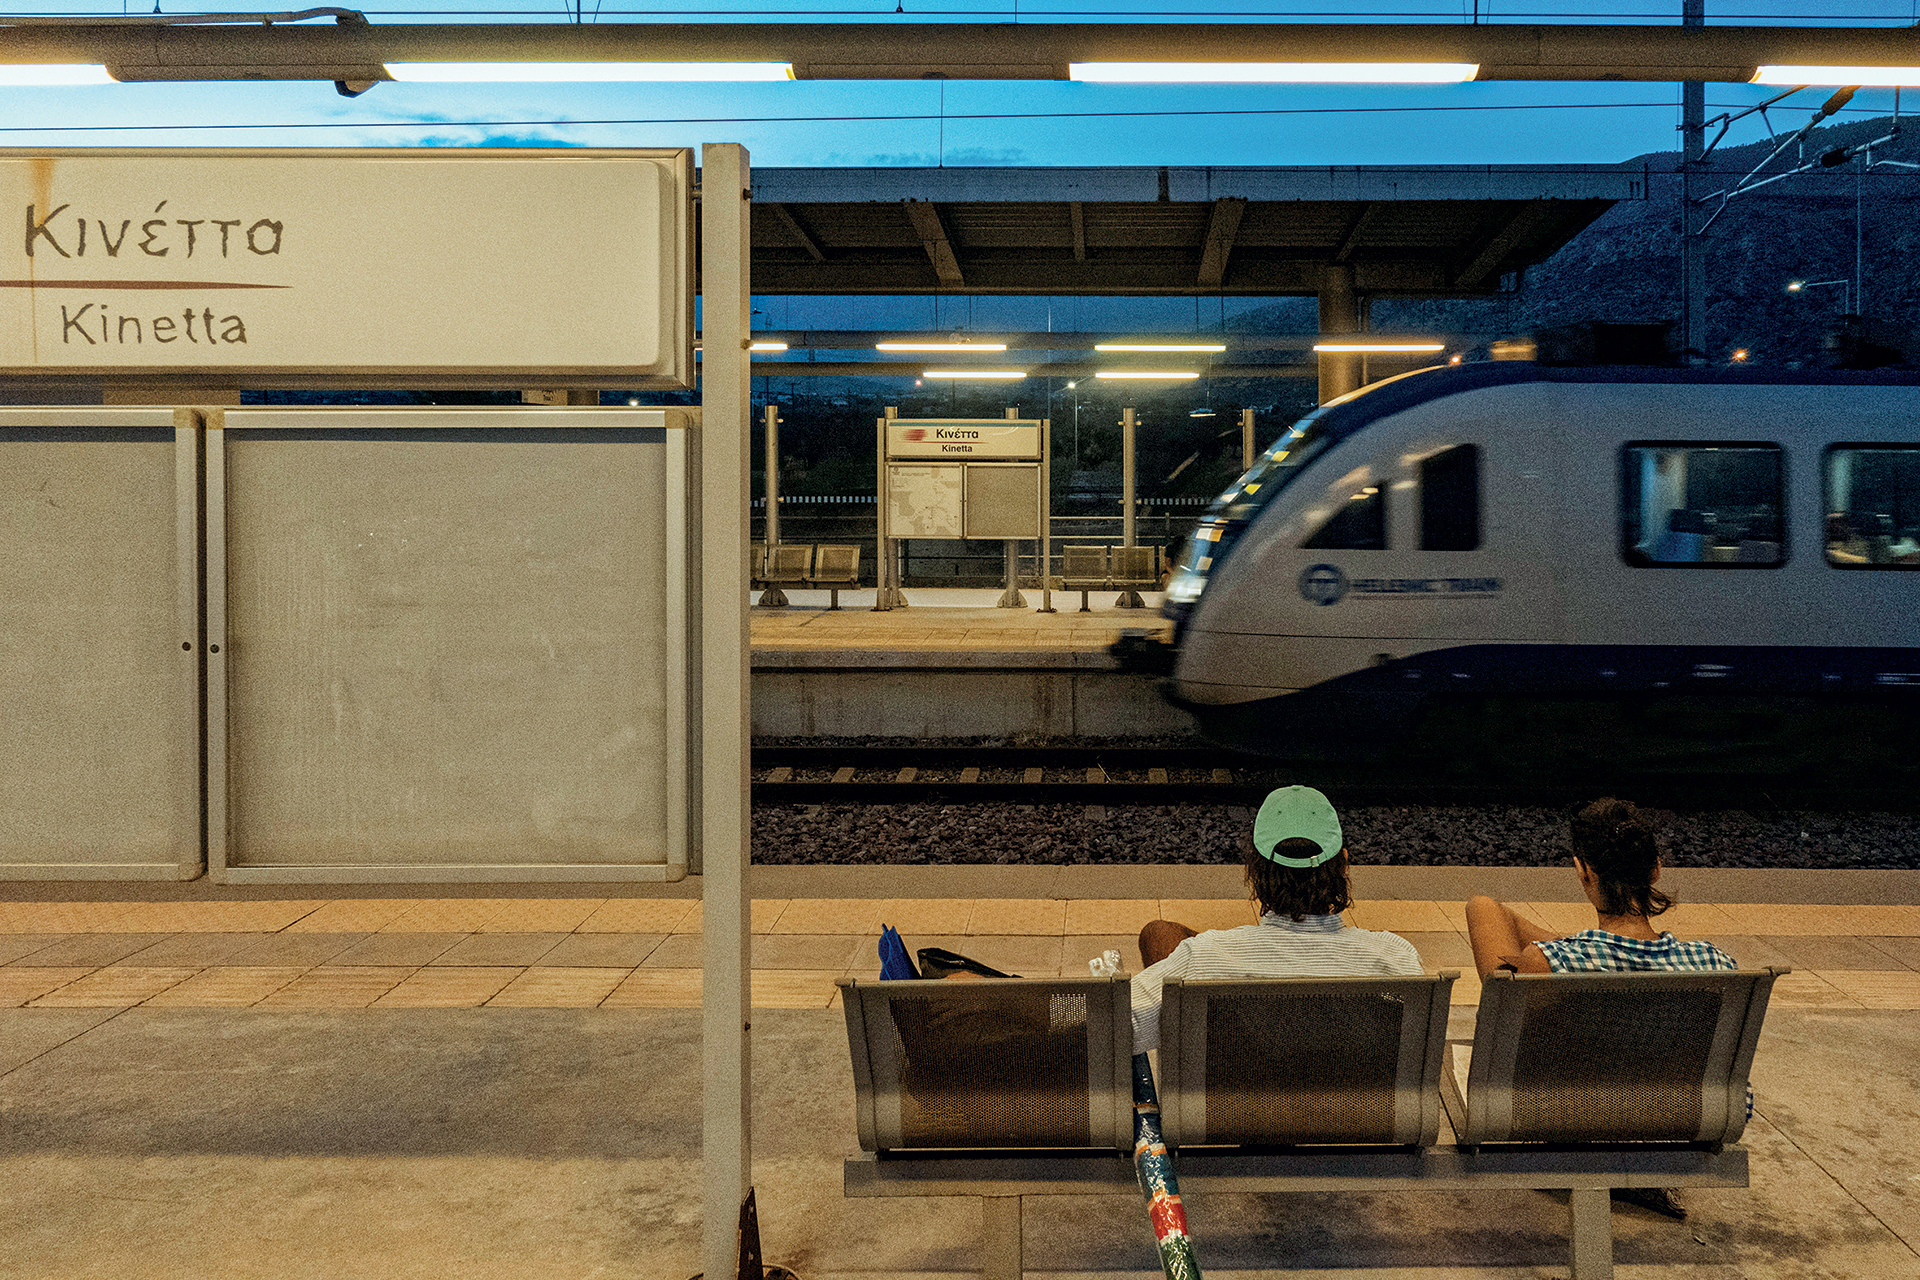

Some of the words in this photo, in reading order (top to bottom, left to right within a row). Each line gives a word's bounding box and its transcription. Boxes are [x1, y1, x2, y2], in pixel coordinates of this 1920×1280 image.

[24, 200, 285, 259] Κινέττα
[61, 303, 248, 345] Kinetta
[936, 428, 979, 439] Κινέττα
[941, 444, 973, 453] Kinetta
